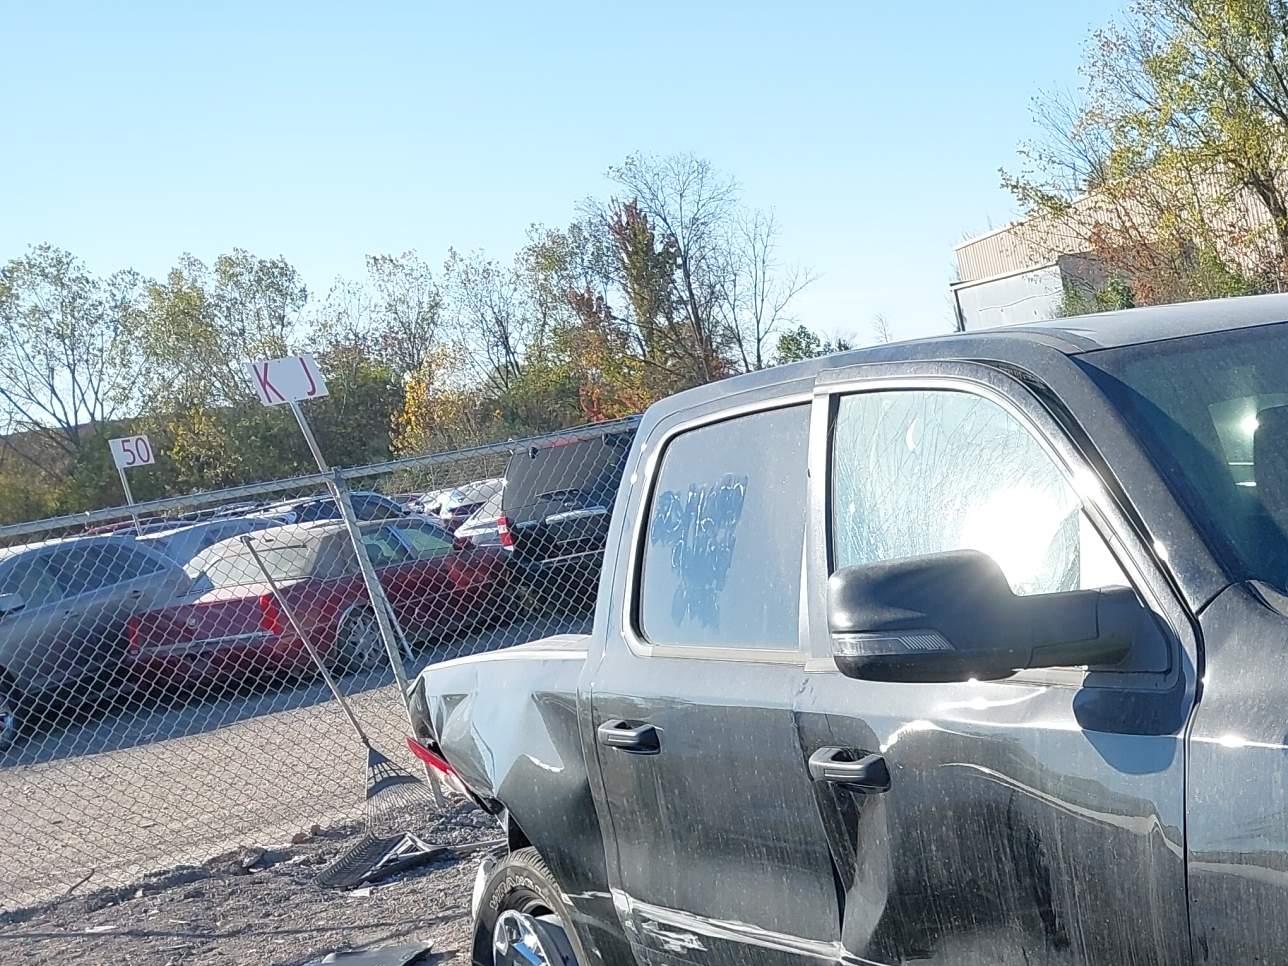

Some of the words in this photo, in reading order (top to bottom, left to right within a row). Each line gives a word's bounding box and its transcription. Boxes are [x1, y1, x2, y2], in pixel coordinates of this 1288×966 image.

[252, 362, 286, 403] K
[299, 357, 316, 396] J
[121, 437, 150, 465] 50
[489, 875, 556, 911] WRANGL
